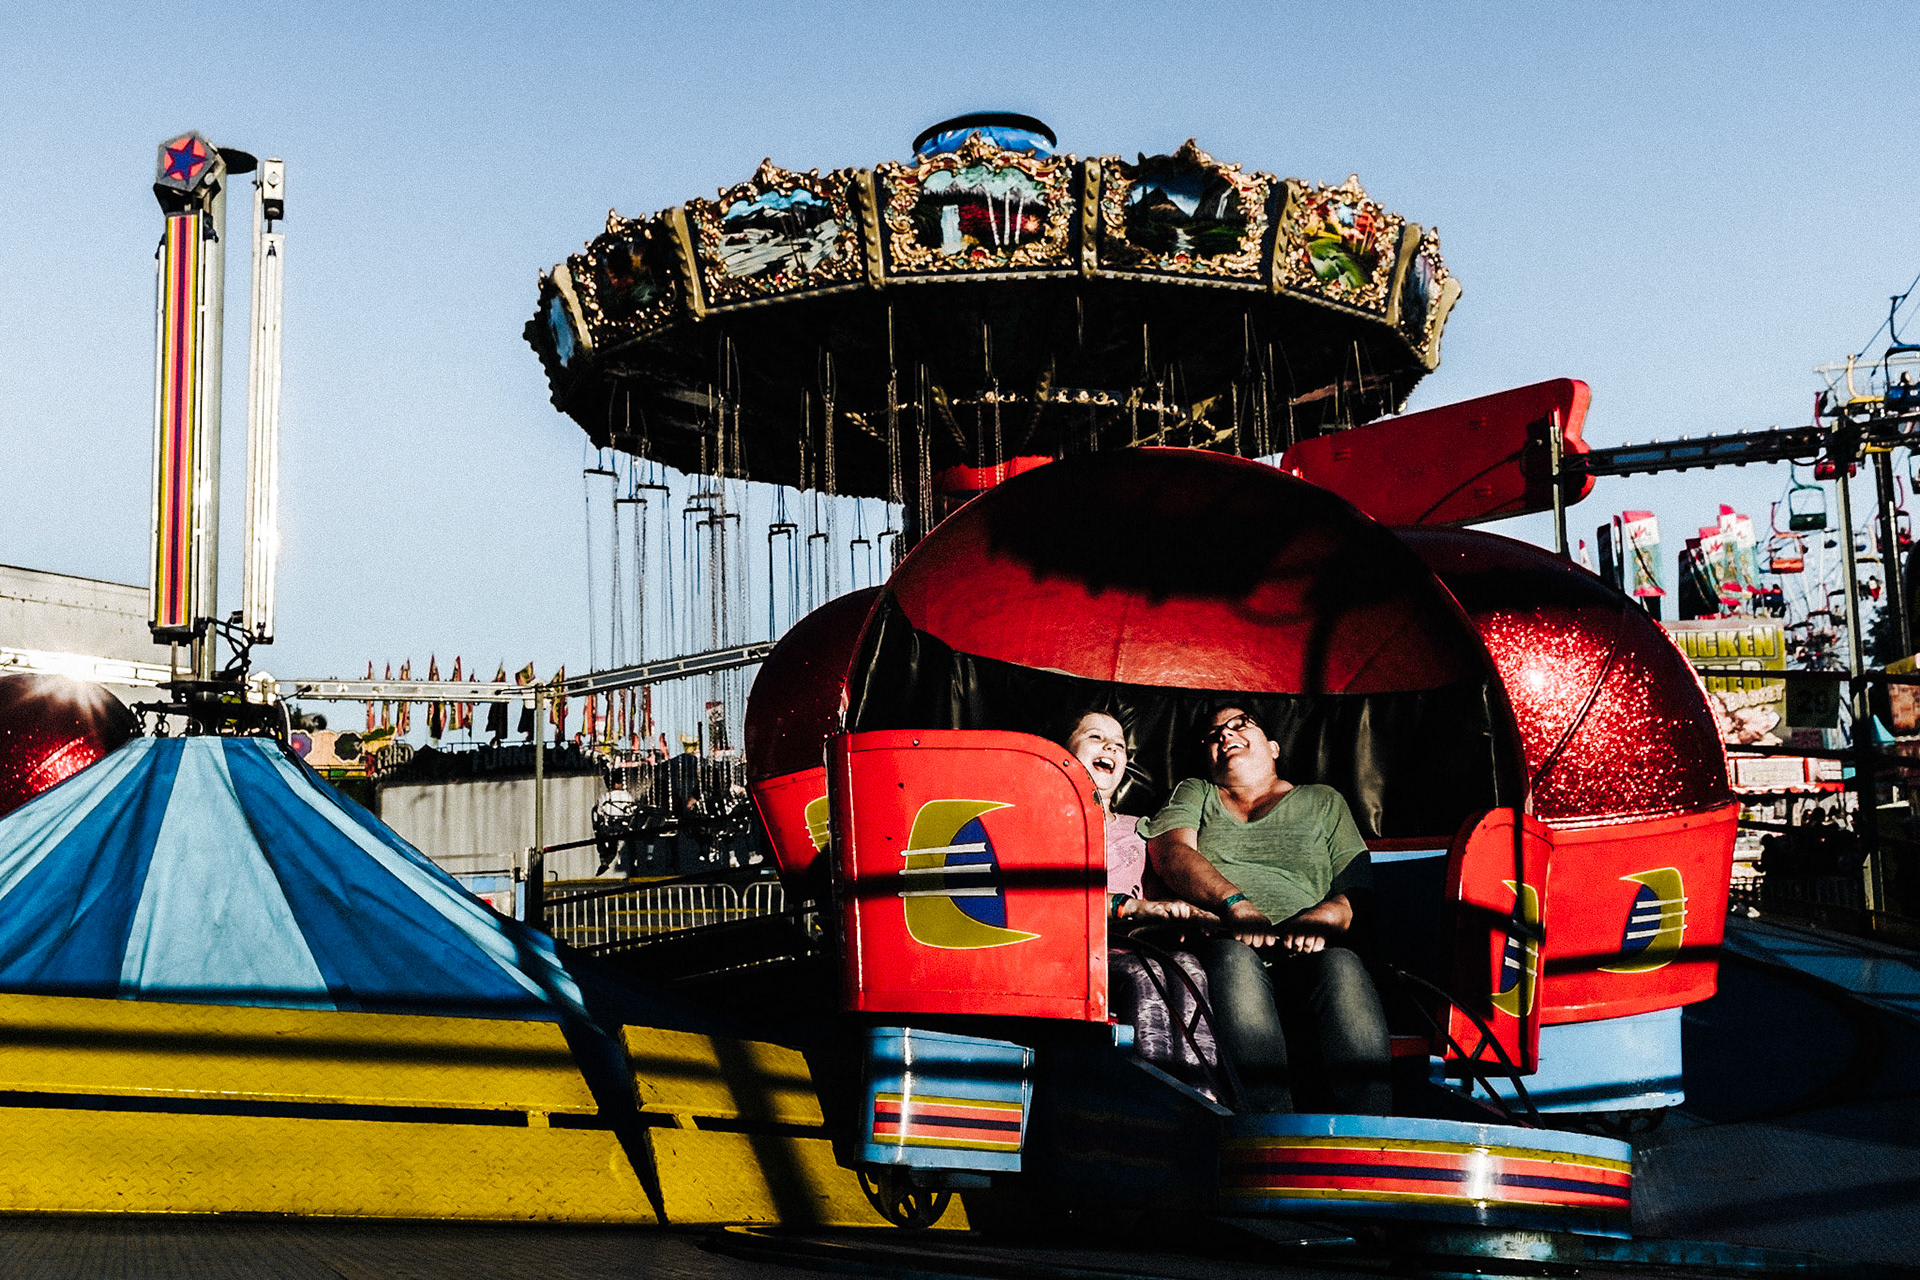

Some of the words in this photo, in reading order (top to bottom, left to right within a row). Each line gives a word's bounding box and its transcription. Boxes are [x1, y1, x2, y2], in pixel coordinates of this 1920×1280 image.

[1671, 628, 1774, 657] HICKEN
[1725, 683, 1785, 711] BASKET
[376, 743, 414, 770] FRIED
[472, 746, 550, 773] FUNNE
